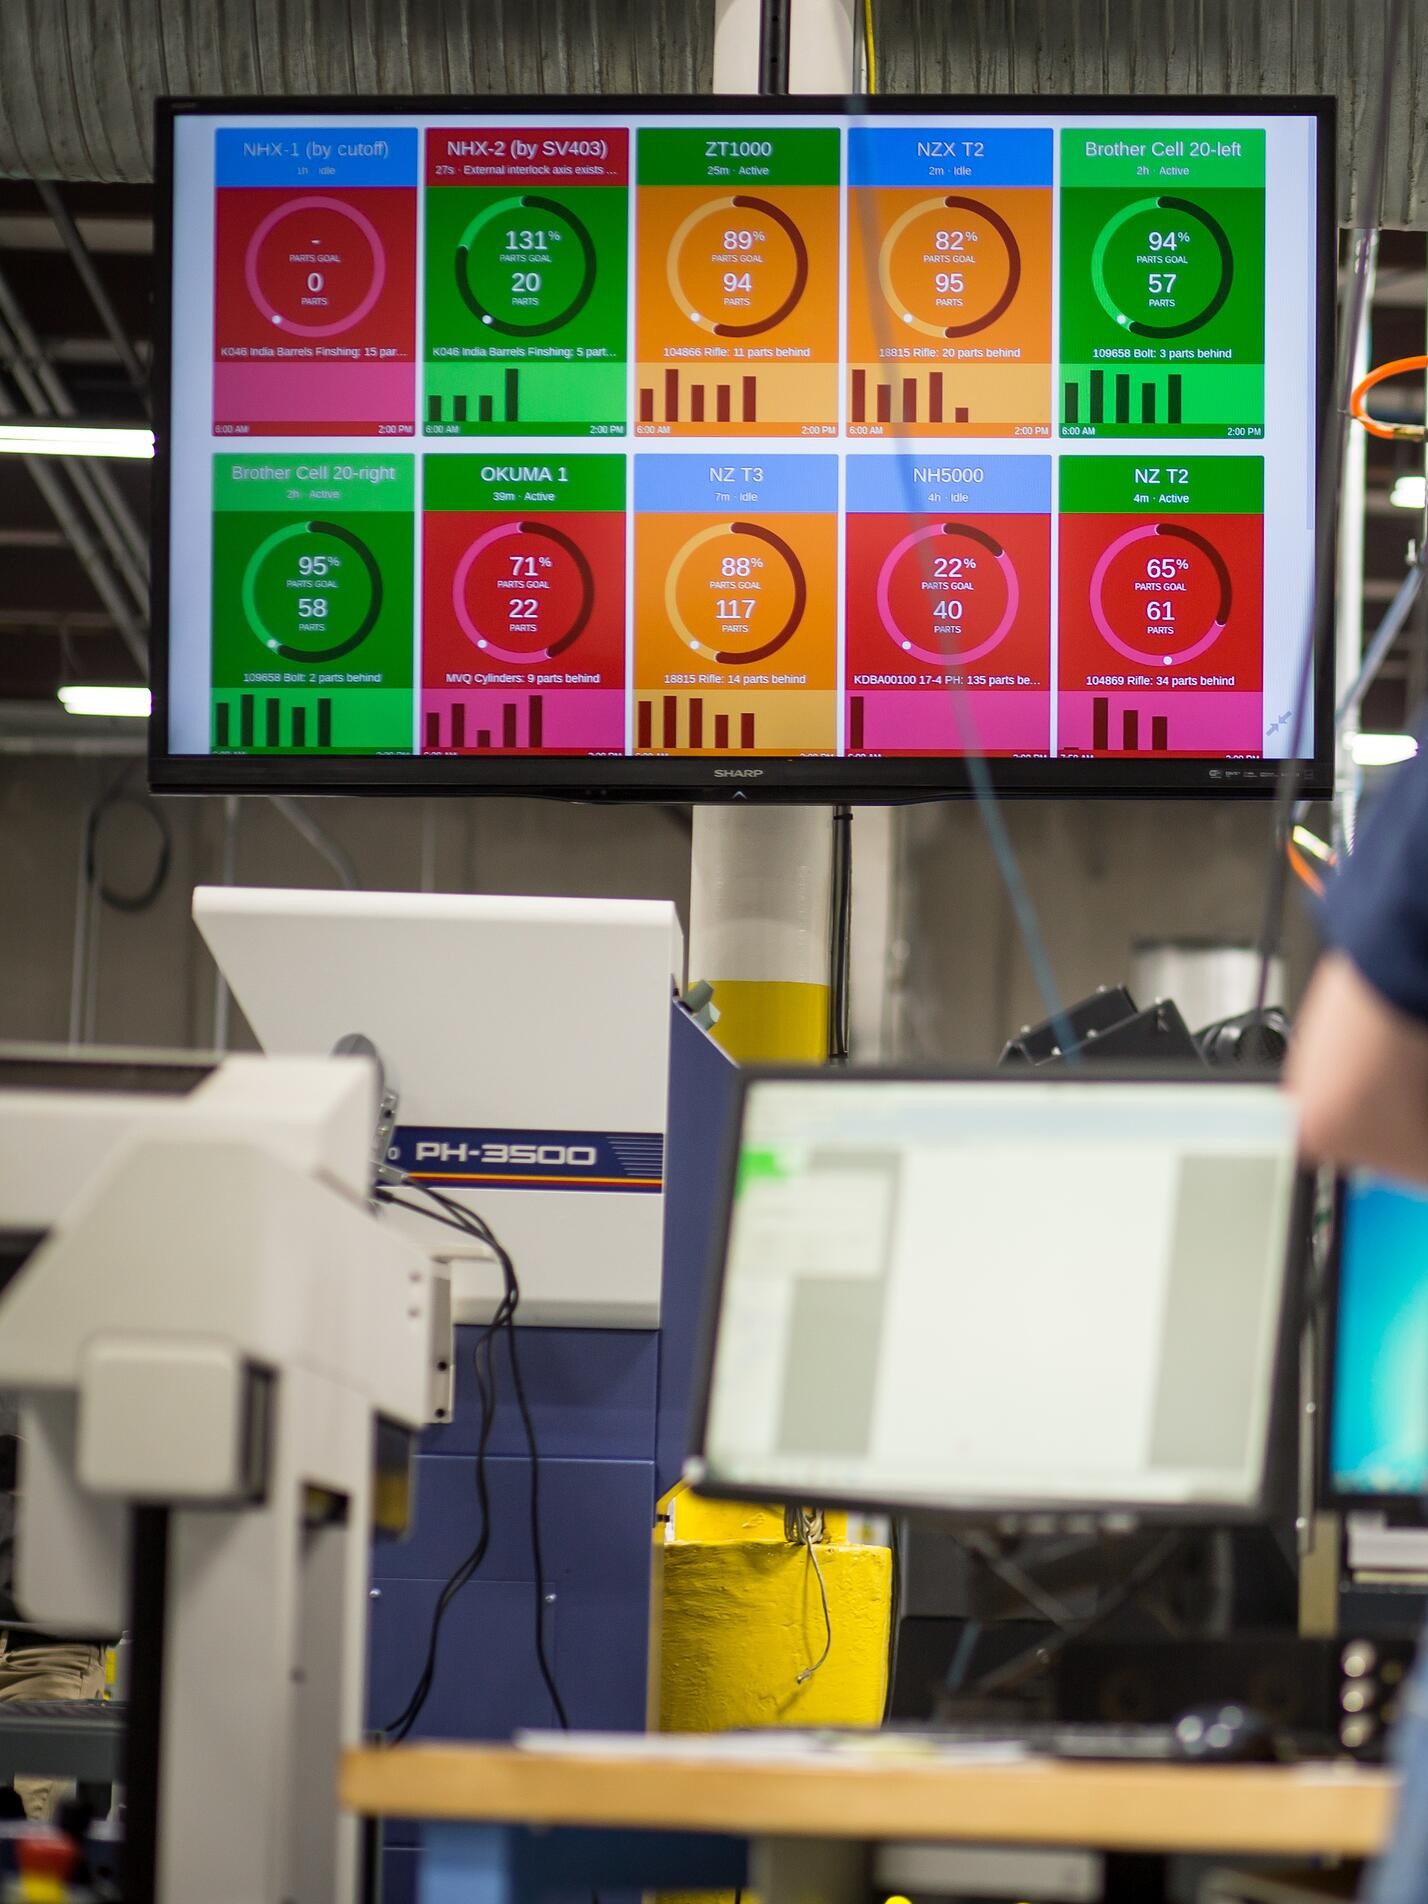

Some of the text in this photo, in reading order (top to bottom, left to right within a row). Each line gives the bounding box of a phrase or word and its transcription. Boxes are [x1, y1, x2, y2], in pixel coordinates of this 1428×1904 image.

[244, 141, 388, 159] NHX-1 (by cutoff)
[448, 140, 607, 159] NHX-2 (by SV403)
[705, 141, 772, 157] ZT1000
[918, 142, 984, 157] NZX T2
[1086, 141, 1241, 157] Brother Cell 20-left
[707, 166, 769, 175] 25m Active
[929, 166, 972, 176] 2m Idle
[1137, 165, 1189, 176] 2h Active
[289, 254, 341, 263] PARTS GOAL
[500, 254, 552, 262] PARTS GOAL
[712, 254, 763, 263] PARTS GOAL
[923, 255, 975, 263] PARTS GOAL
[1136, 255, 1188, 264] PARTS GOAL
[308, 273, 323, 292] 0
[512, 272, 540, 292] 20
[723, 273, 752, 292] 94
[935, 273, 964, 293] 95
[1149, 274, 1176, 293] 57
[301, 297, 328, 305] PARTS
[512, 297, 539, 305] PARTS
[724, 298, 751, 306] PARTS
[935, 298, 963, 306] PARTS
[1149, 299, 1175, 307] PARTS
[664, 347, 703, 357] 104866
[734, 348, 745, 357] 11
[747, 348, 775, 358] parts
[774, 347, 811, 357] behind
[942, 348, 957, 358] 20
[956, 348, 985, 359] parts
[986, 348, 1021, 358] behind
[1093, 348, 1232, 360] 109658 Bolt: 3 parts behind
[1062, 427, 1095, 435] 6:00 AM
[1227, 427, 1261, 436] 2:00 PM
[232, 465, 396, 484] Brother Cell 20-right
[481, 467, 568, 482] OKUMA 1
[710, 467, 764, 482] NZ T3
[914, 468, 984, 482] NH5000
[1135, 469, 1188, 484] NZ T2
[493, 492, 555, 501] 39m Active
[715, 492, 758, 501] 7m Idle
[928, 493, 968, 502] 4h Idle
[1133, 494, 1189, 503] 4m Active
[287, 580, 337, 588] PARTS GOAL
[497, 580, 550, 589] PARTS GOAL
[710, 581, 761, 589] PARTS GOAL
[922, 582, 974, 590] PARTS GOAL
[1135, 583, 1187, 591] PARTS GOAL
[298, 598, 327, 617] 58
[509, 599, 538, 618] 22
[716, 599, 756, 619] 117
[933, 601, 962, 619] 40
[1147, 601, 1175, 620] 61
[299, 623, 325, 631] PARTS
[510, 624, 537, 632] PARTS
[722, 624, 749, 633] PARTS
[934, 625, 961, 633] PARTS
[1147, 626, 1174, 634] PARTS
[446, 673, 600, 685] MVQ Cylinders: 9 parts behind
[665, 674, 697, 684] 18815
[728, 675, 742, 684] 14
[742, 675, 770, 686] parts
[770, 675, 806, 684] behind
[854, 675, 916, 684] KDBA00100
[919, 675, 942, 684] 17-4
[967, 675, 986, 685] 135
[989, 676, 1015, 687] parts
[1086, 676, 1124, 685] 104869
[1156, 676, 1169, 685] 34
[1172, 677, 1198, 688] parts
[1200, 676, 1235, 686] behind
[714, 769, 763, 778] SHARP
[415, 1141, 598, 1166] PH-3500
